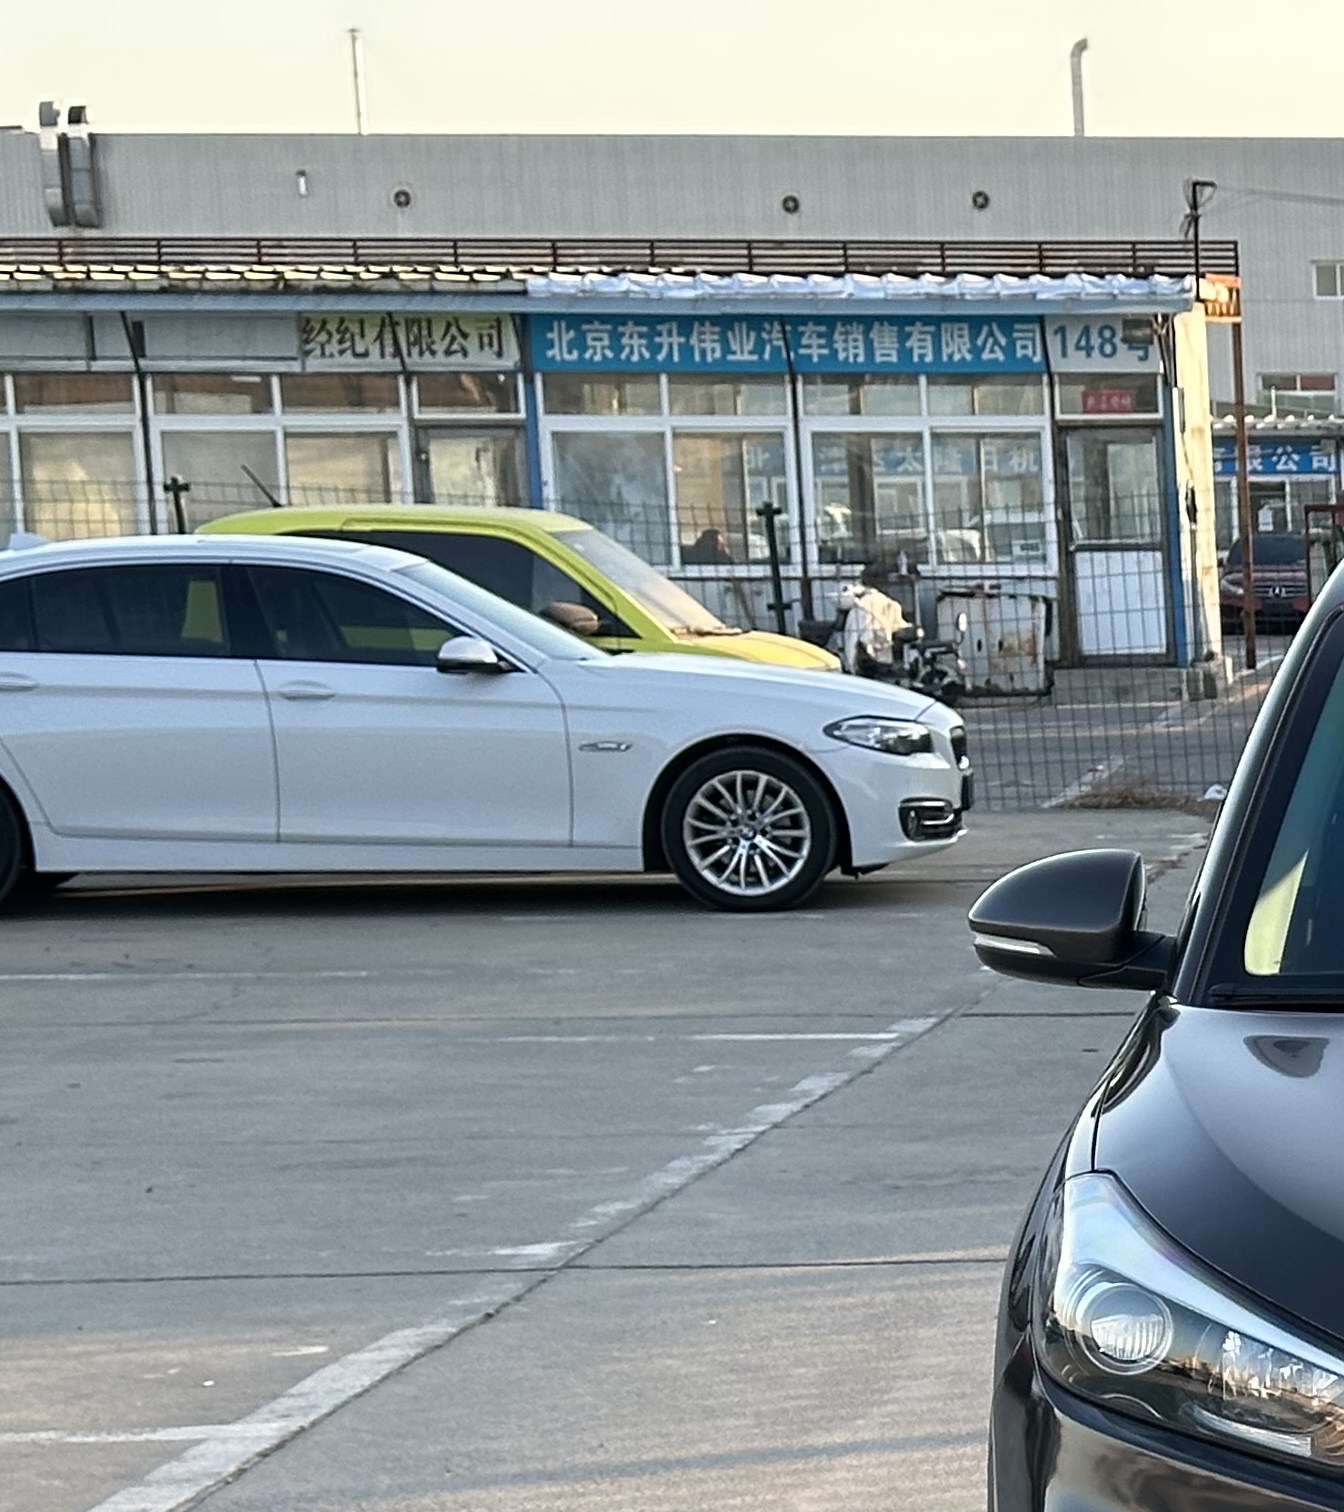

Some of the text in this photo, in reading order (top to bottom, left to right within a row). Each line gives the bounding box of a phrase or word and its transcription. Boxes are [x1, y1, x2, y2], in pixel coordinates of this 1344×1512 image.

[546, 320, 1043, 364] 北京东升伟业汽车销售有限公司
